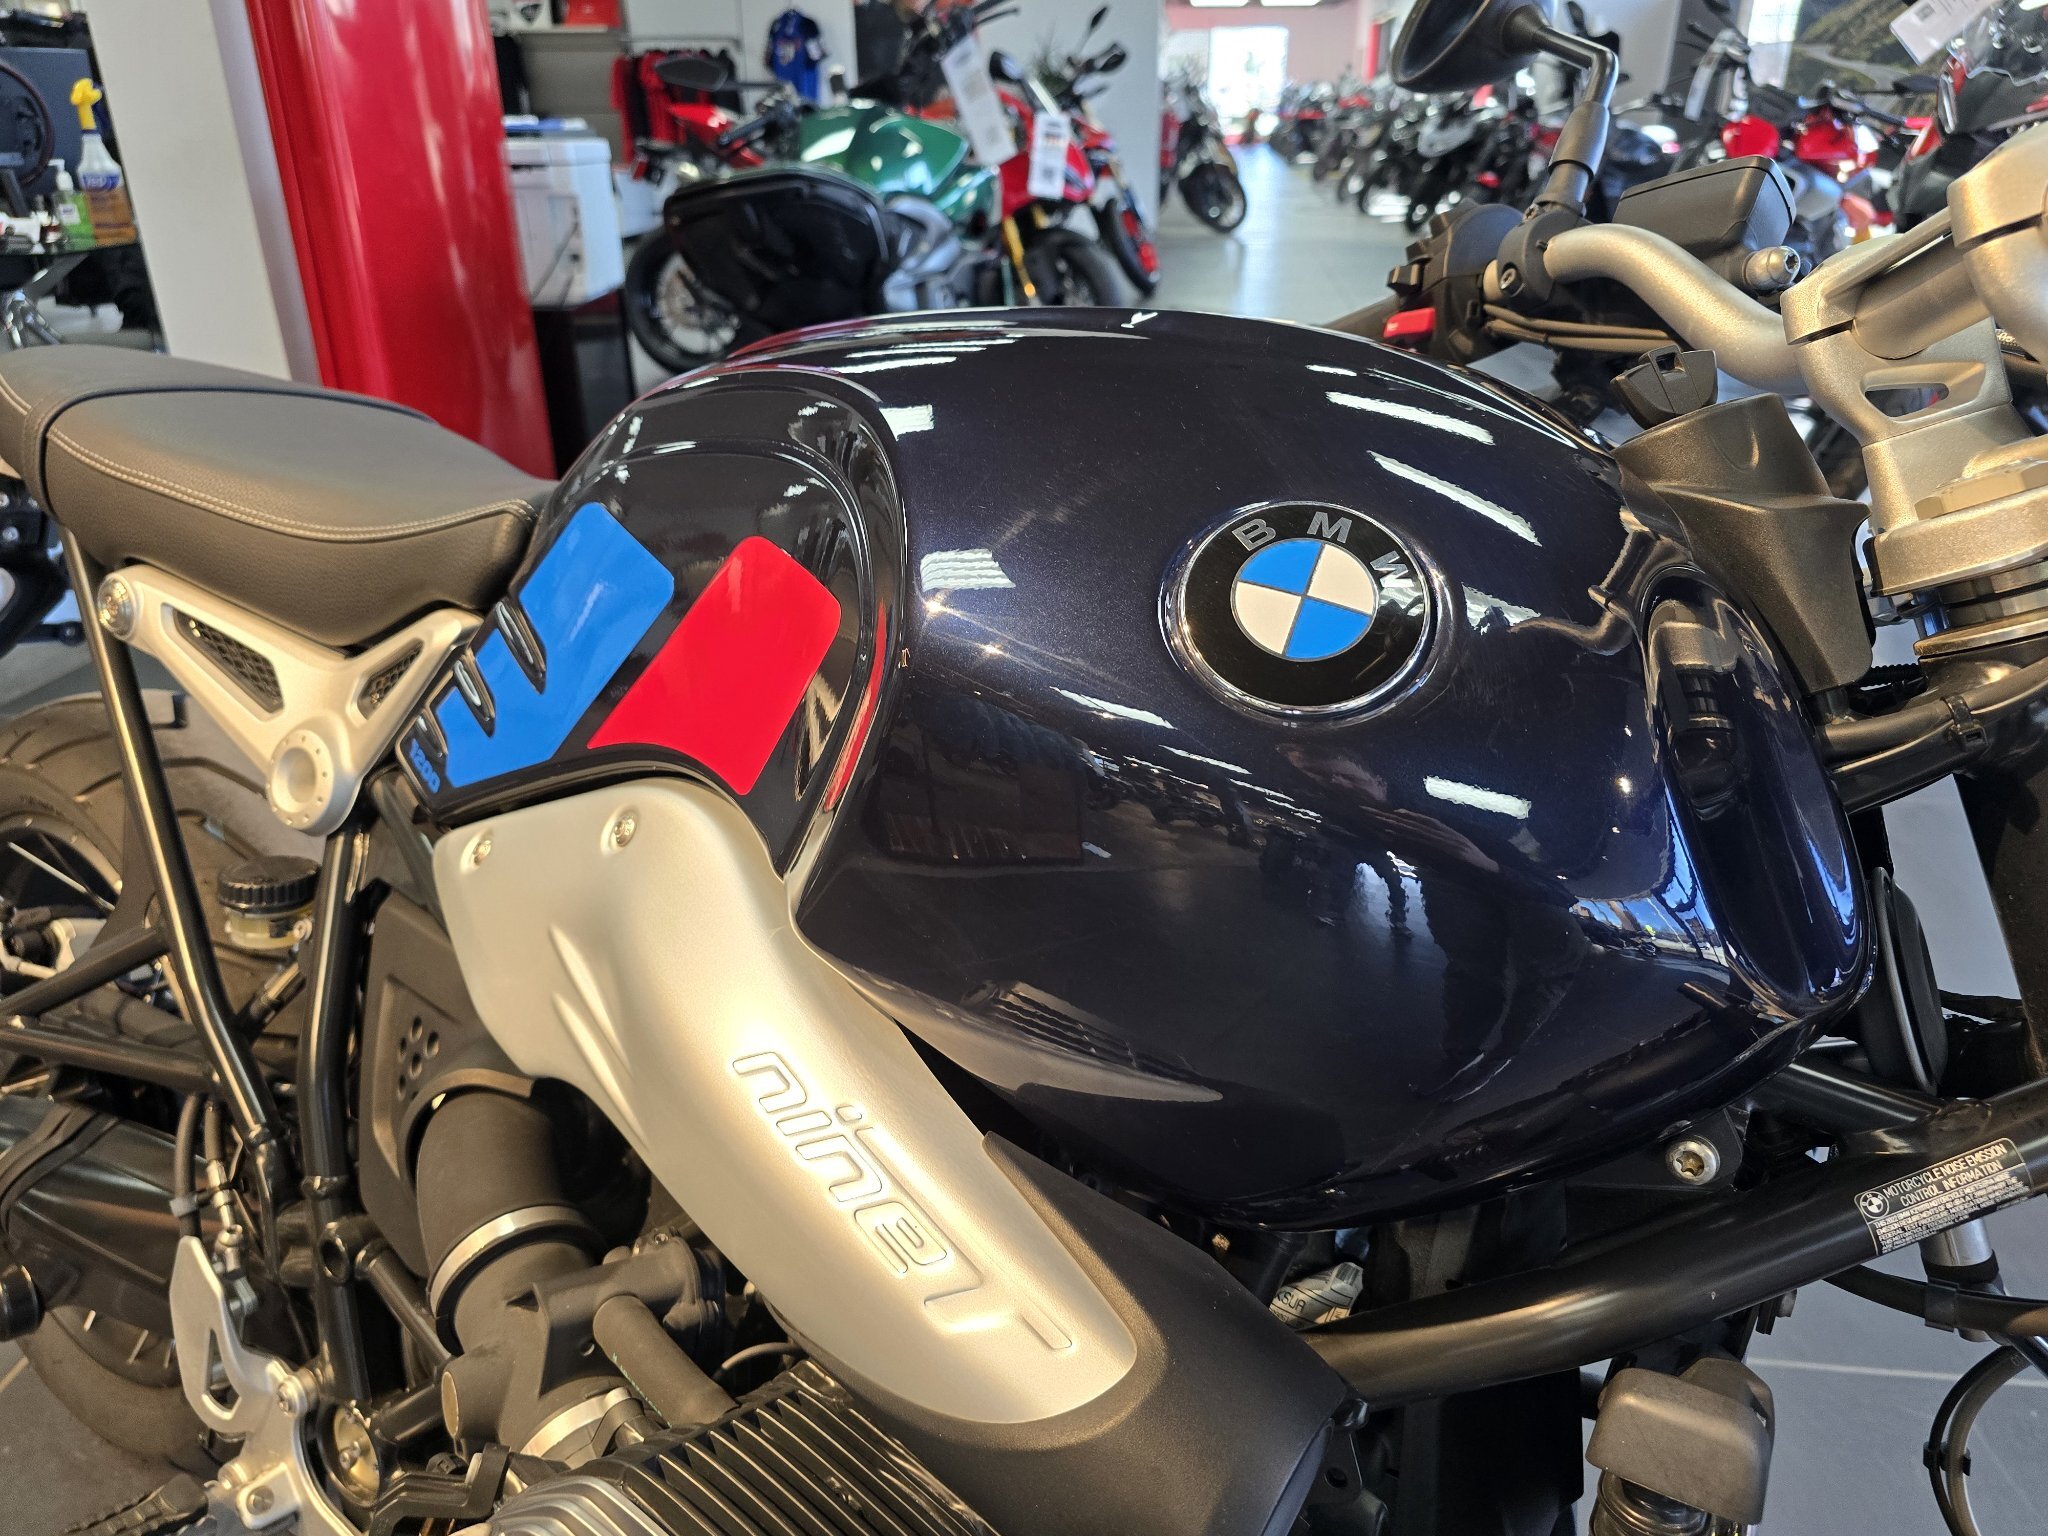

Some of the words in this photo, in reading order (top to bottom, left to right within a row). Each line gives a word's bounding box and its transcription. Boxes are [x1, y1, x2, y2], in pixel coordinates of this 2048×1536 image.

[1232, 512, 1414, 588] BMW
[1883, 1168, 1943, 1198] MOTORCYCLE
[1943, 1160, 1967, 1176] NOISE
[1967, 1143, 2007, 1166] EMISSION
[1900, 1183, 1943, 1207] CONTROL
[1944, 1160, 2003, 1190] INFORMATION
